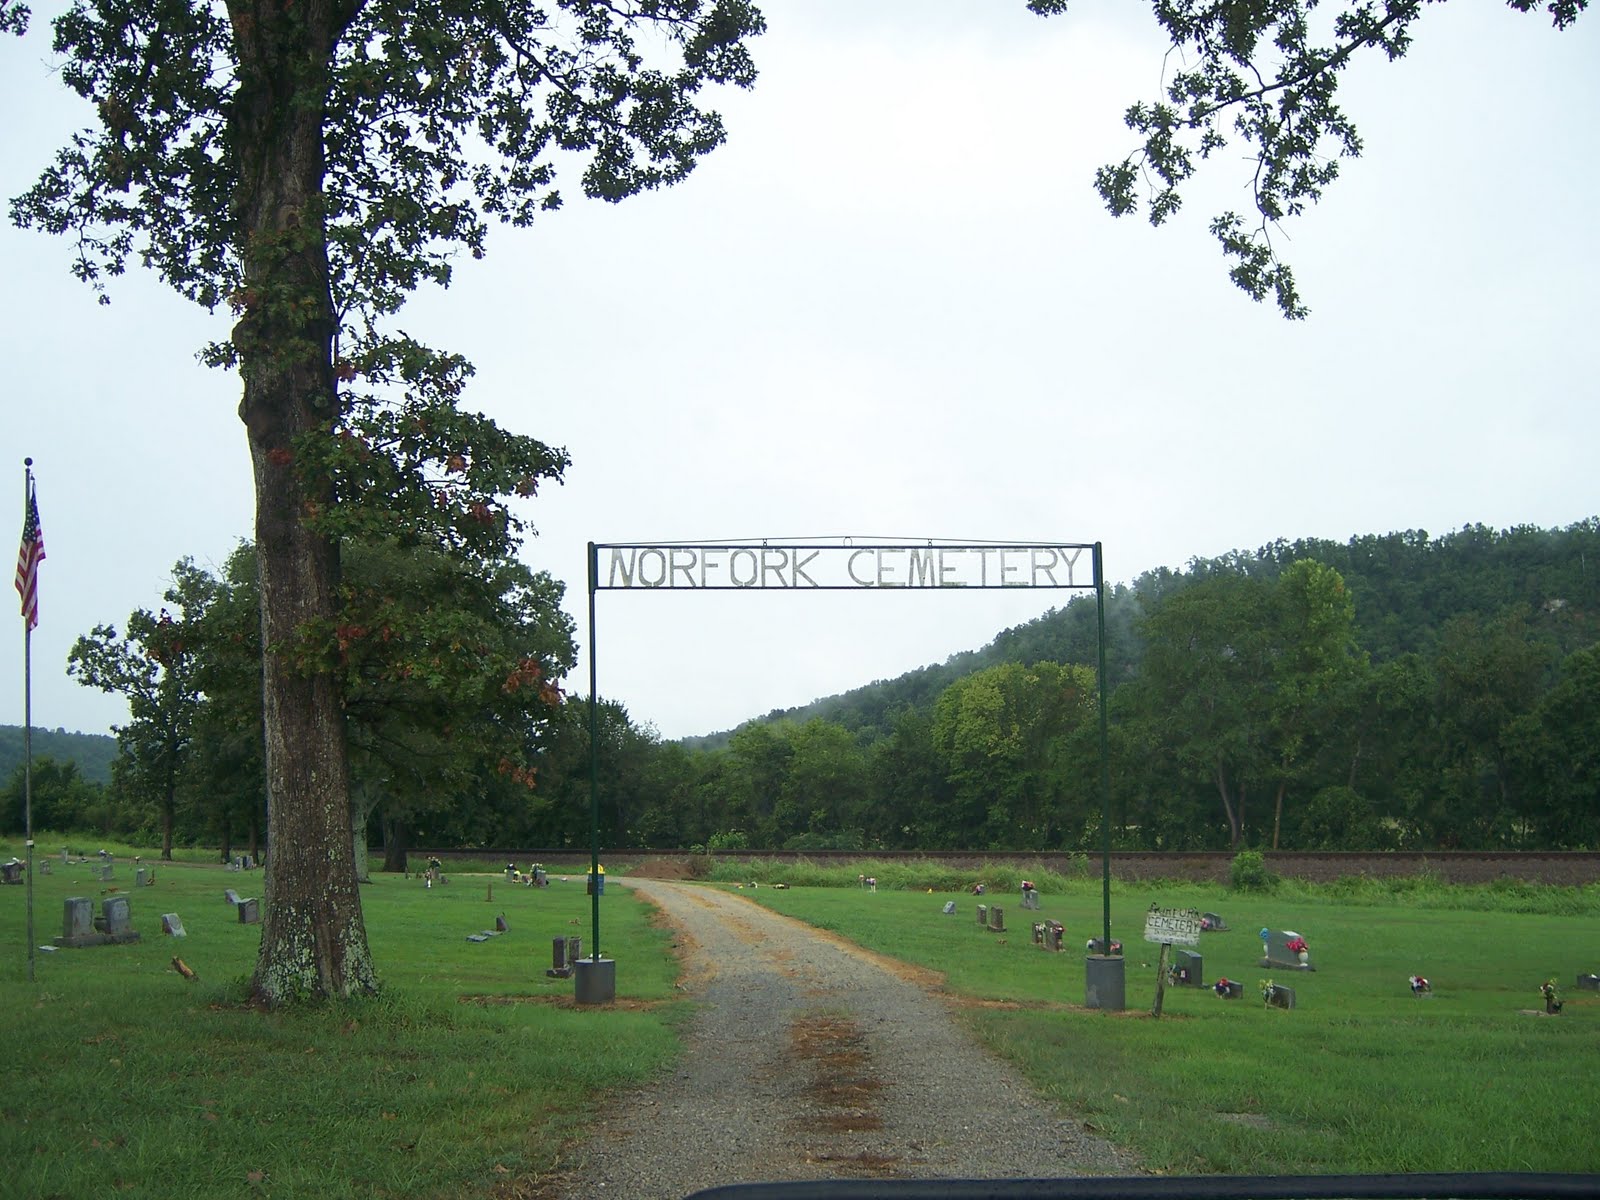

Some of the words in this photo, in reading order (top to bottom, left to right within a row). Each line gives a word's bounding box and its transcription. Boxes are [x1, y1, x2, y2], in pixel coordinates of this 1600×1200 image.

[610, 548, 819, 587] NORFORK
[849, 548, 1081, 587] CEMETERY
[1148, 916, 1199, 934] CEMETERY
